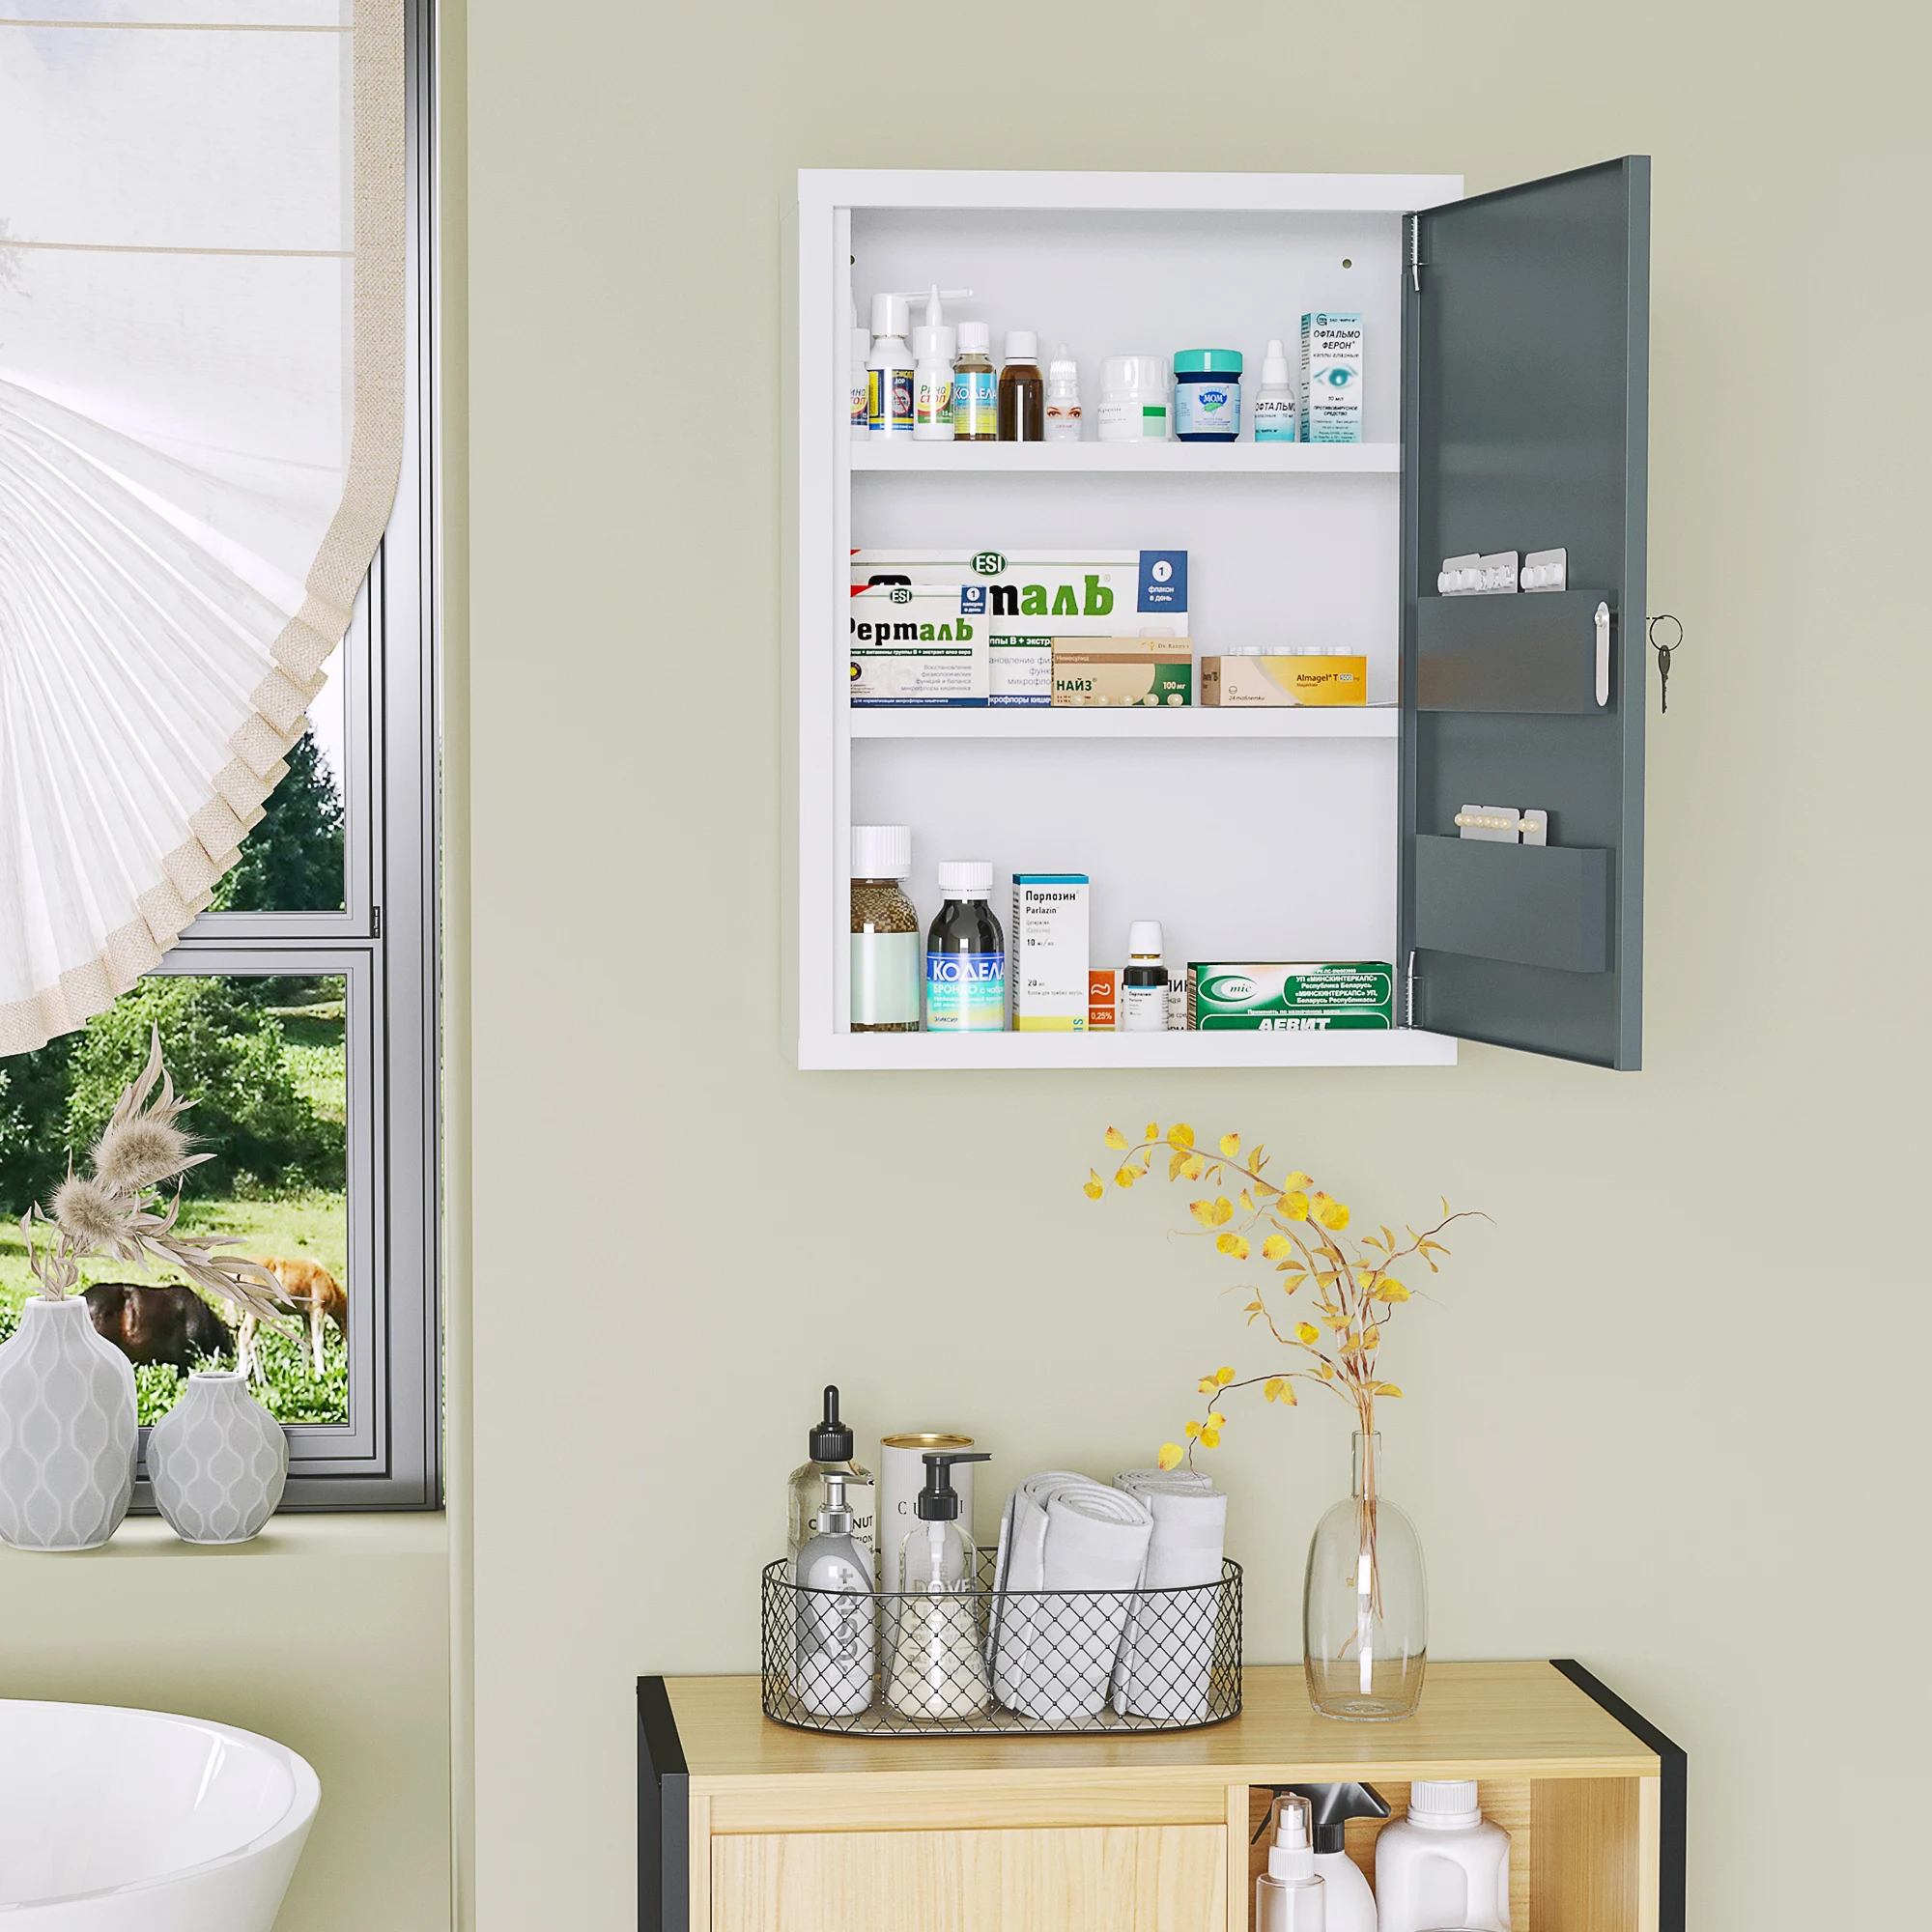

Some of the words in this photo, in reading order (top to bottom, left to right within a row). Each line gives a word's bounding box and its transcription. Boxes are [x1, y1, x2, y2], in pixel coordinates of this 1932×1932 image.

[1314, 329, 1360, 338] ОФТАЛЬМО
[976, 555, 1002, 573] ESI
[1159, 567, 1164, 577] 1
[892, 591, 910, 602] ESI
[1057, 677, 1092, 691] НАЙЗ
[1296, 673, 1329, 684] Almagel
[1026, 891, 1076, 903] Парлазин
[1230, 983, 1251, 992] mic
[1091, 1011, 1113, 1020] 0,25%
[1258, 1017, 1331, 1031] АЕВИТ
